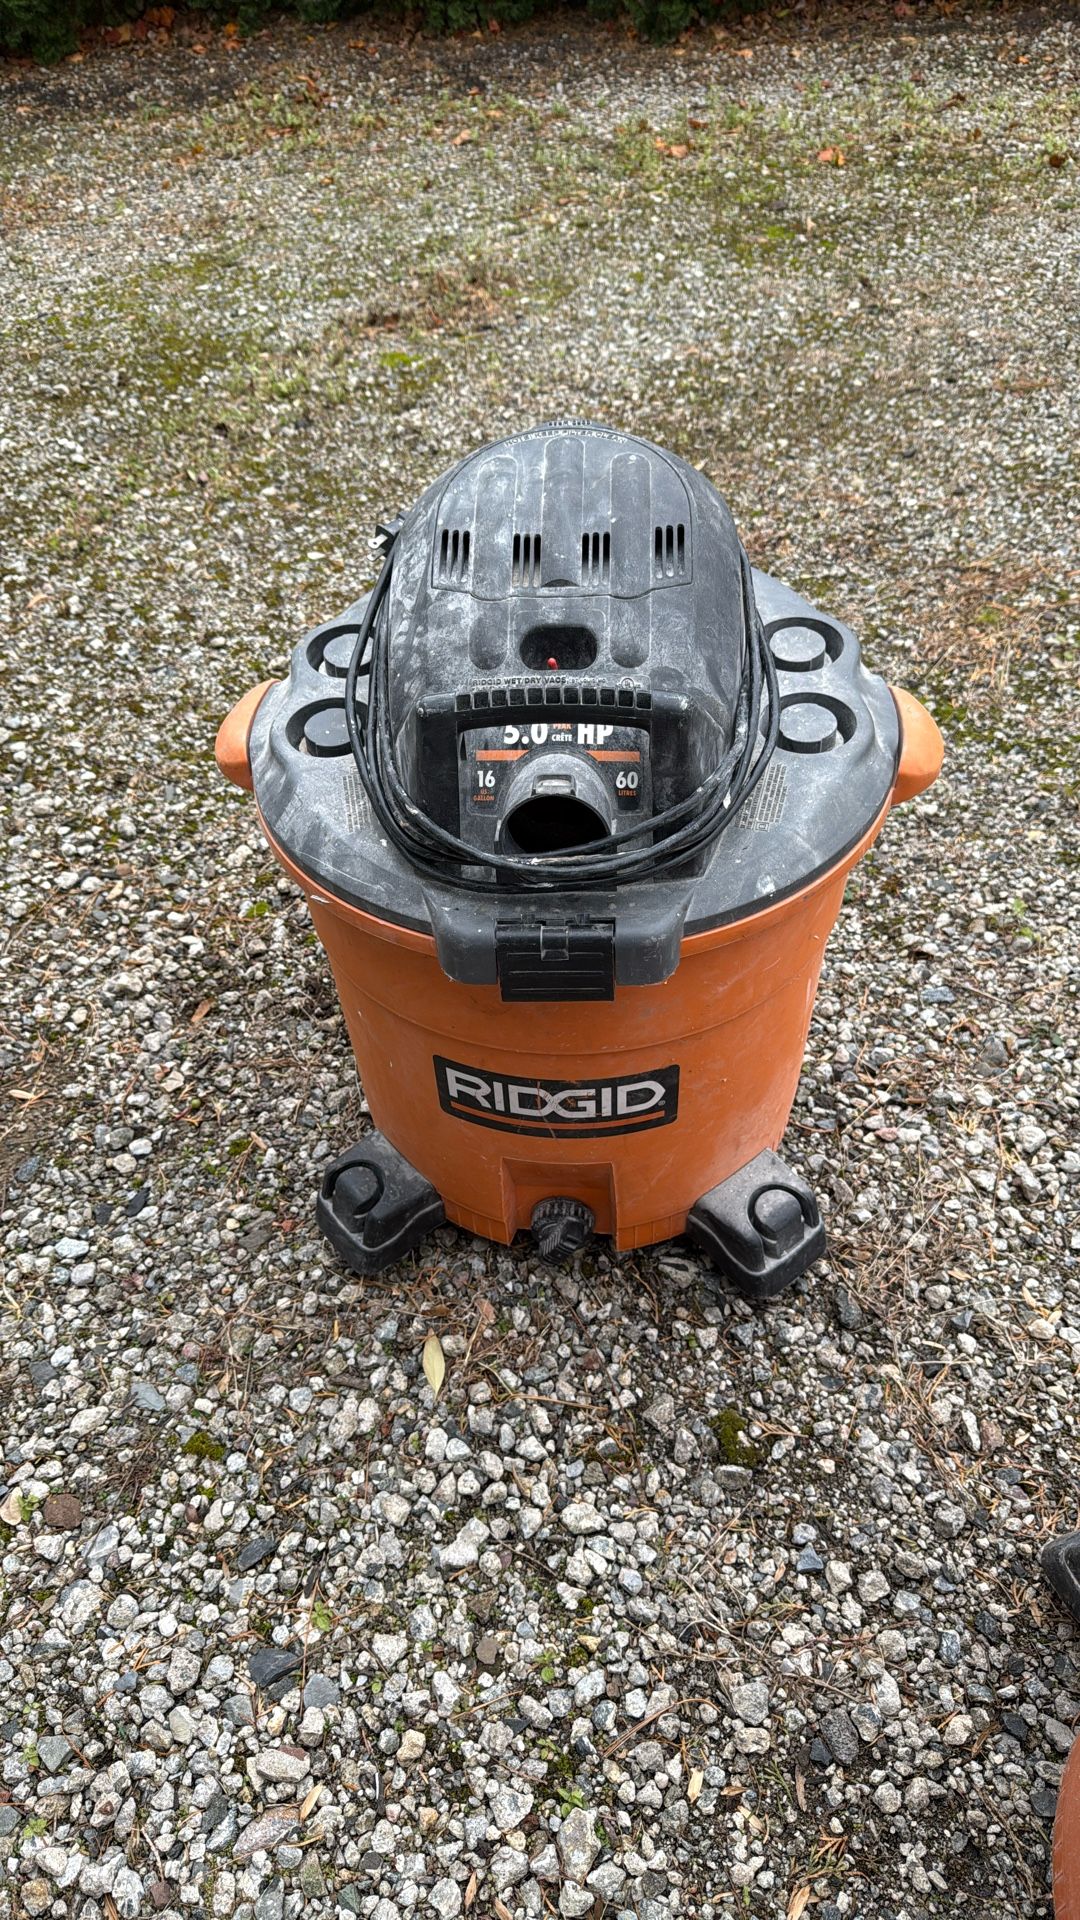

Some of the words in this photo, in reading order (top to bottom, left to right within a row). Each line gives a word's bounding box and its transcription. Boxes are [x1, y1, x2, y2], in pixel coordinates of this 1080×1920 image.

[472, 677, 502, 687] RIDGID
[503, 723, 548, 744] 5.0
[577, 723, 614, 744] HP
[551, 732, 573, 742] CRÊTE
[477, 770, 495, 788] 16
[615, 771, 639, 789] 60
[445, 1066, 666, 1119] RIDGID
